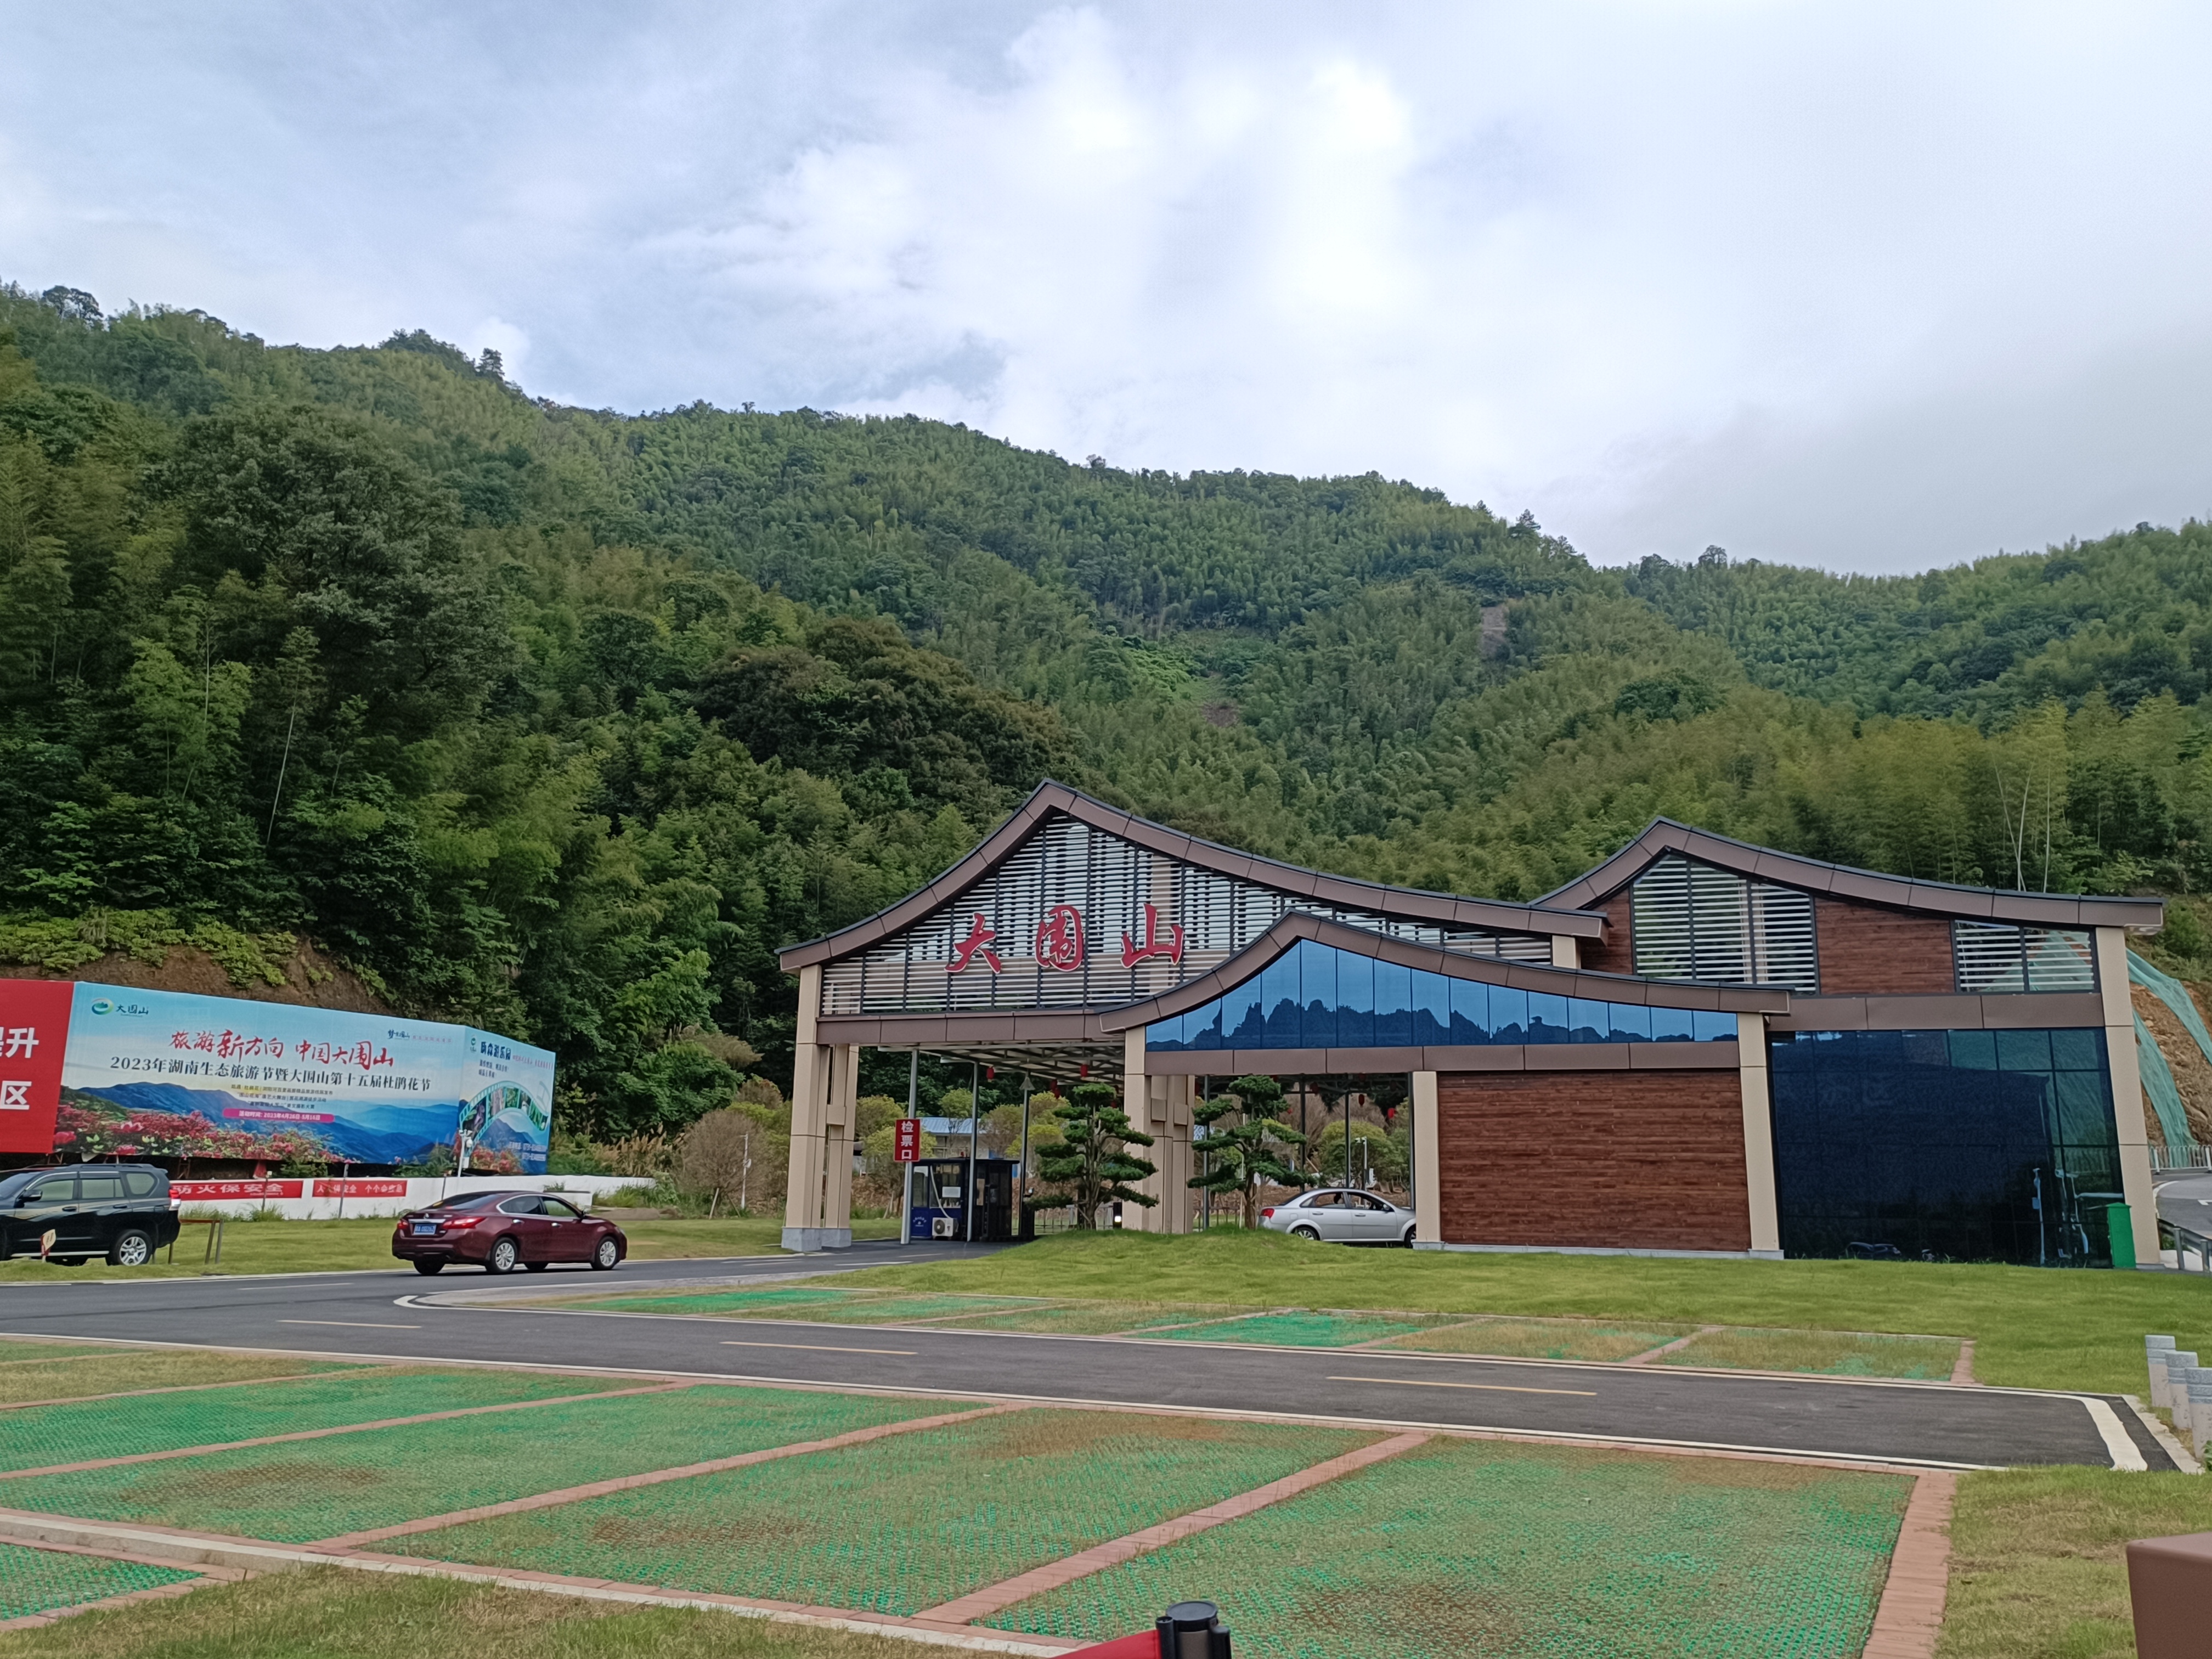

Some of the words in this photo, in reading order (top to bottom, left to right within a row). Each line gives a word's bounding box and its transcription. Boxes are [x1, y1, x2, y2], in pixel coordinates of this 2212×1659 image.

[0, 1026, 40, 1058] 升
[168, 1029, 284, 1063] 旅游新方向
[110, 1057, 431, 1092] 2023年湖南生态旅游节暨大围山第十五届杜鹃花节
[0, 1080, 32, 1110] 区
[901, 1121, 914, 1160] 检票口
[172, 1183, 284, 1195] 防火保安全
